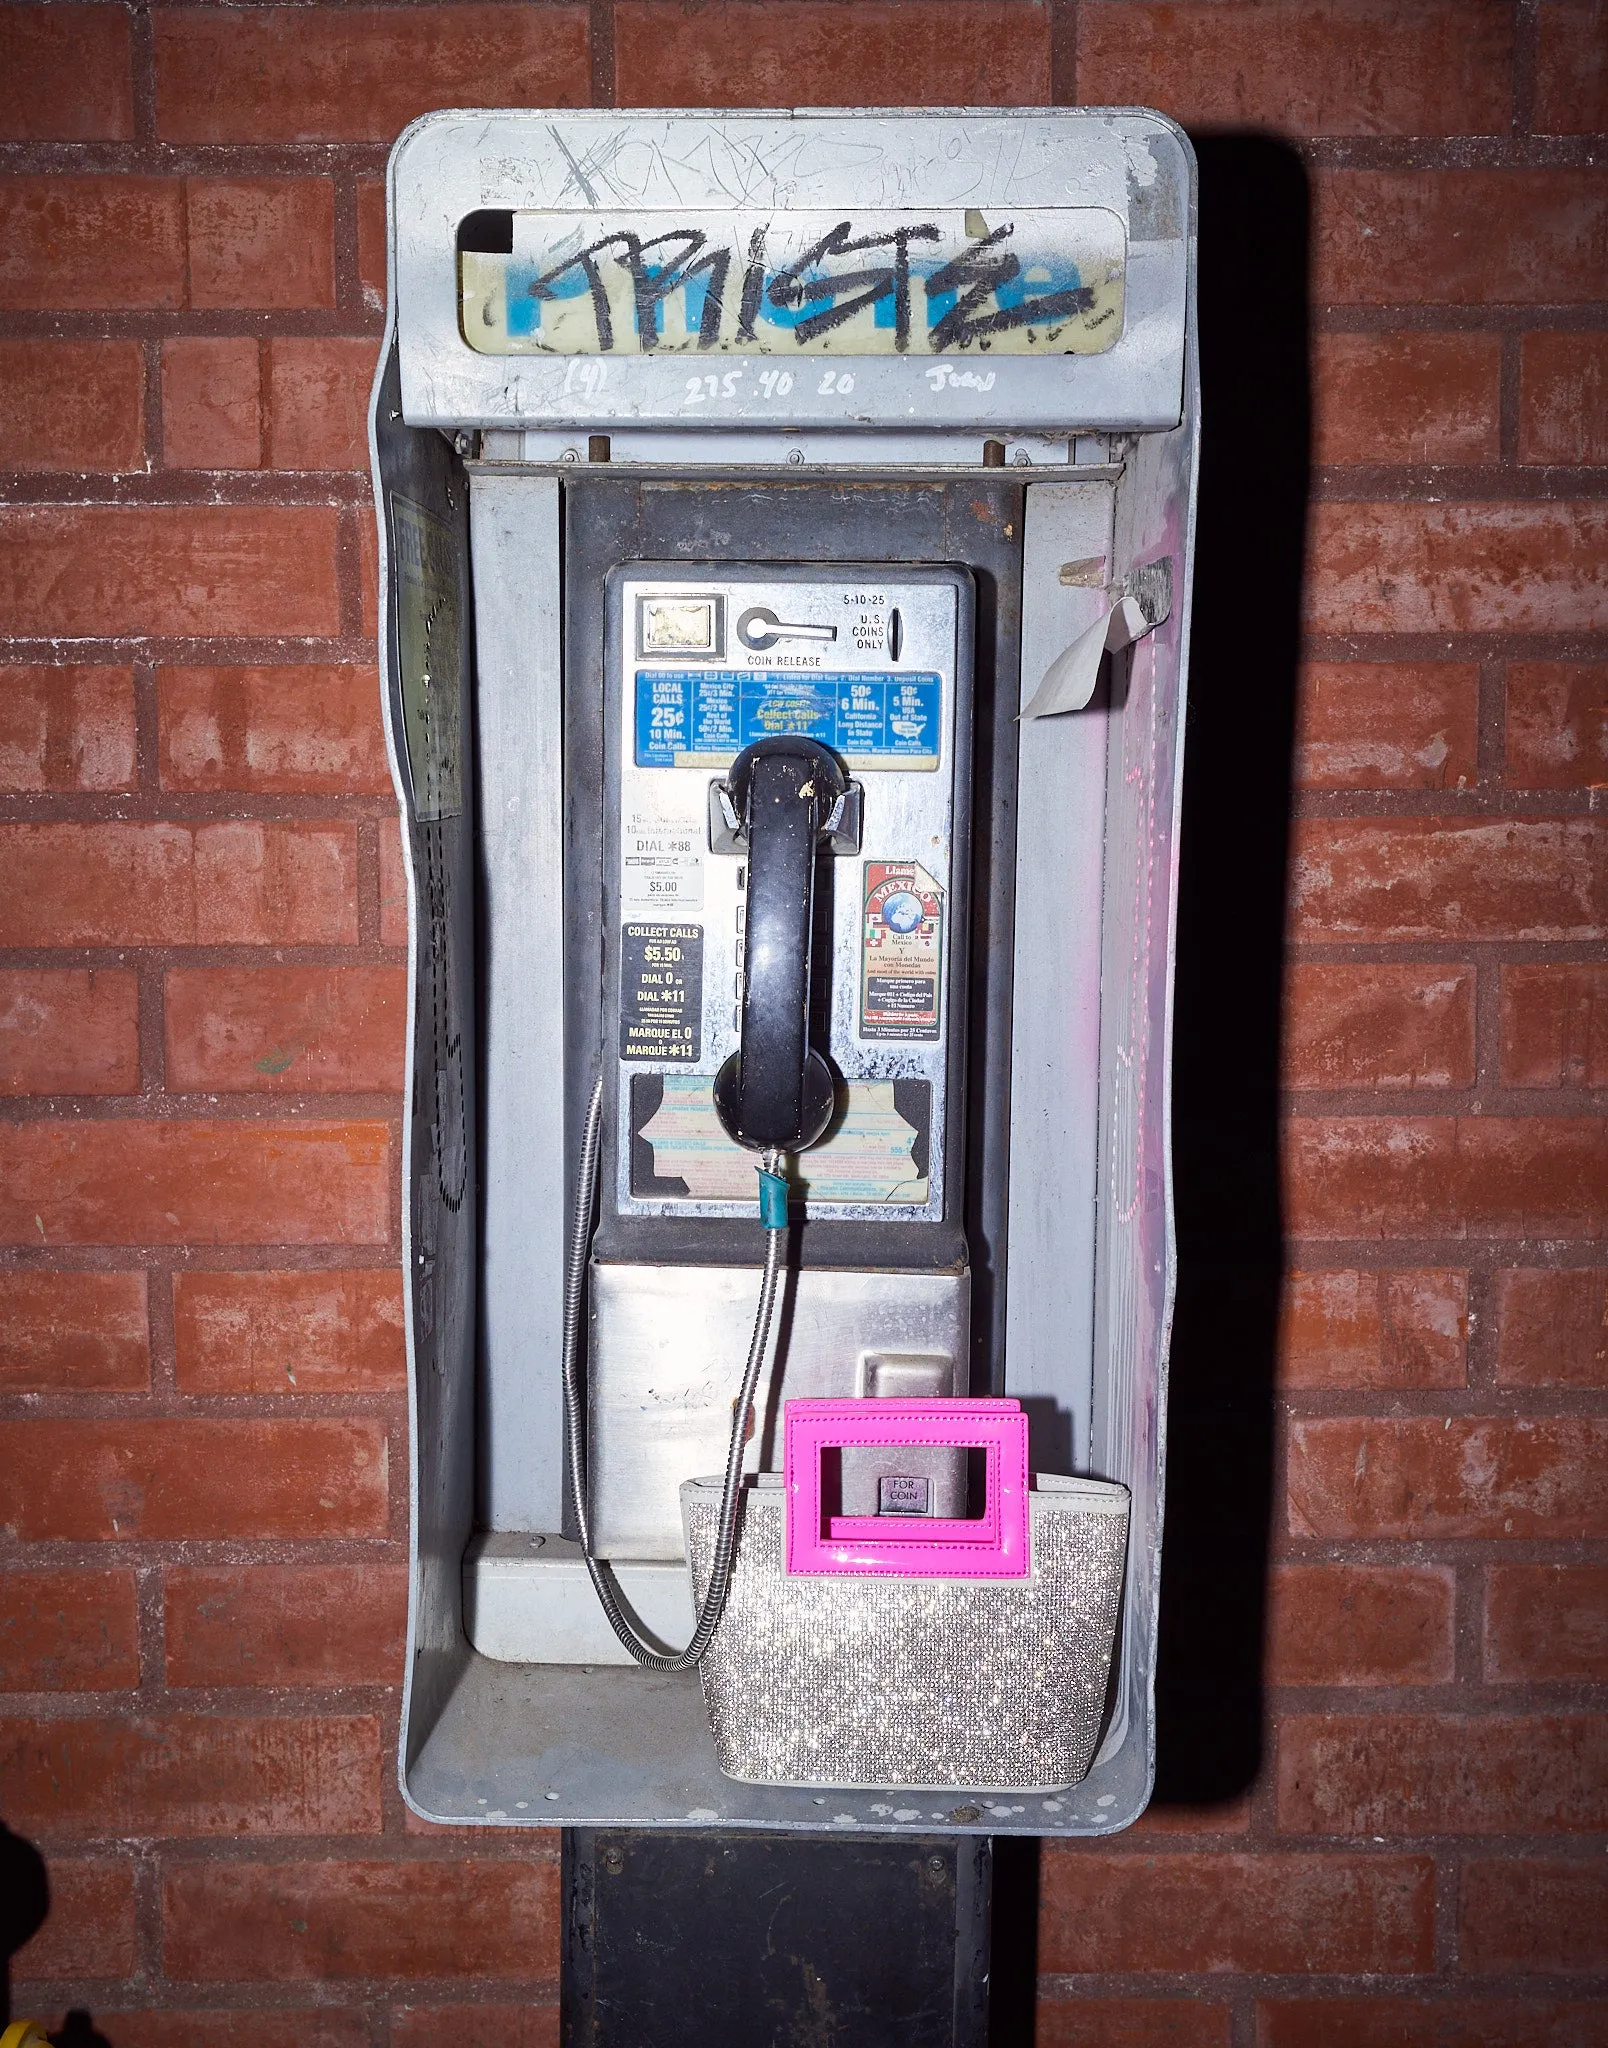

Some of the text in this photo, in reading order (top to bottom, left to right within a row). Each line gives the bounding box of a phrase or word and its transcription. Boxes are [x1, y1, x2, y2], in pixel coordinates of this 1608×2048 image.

[861, 615, 885, 624] U.S.
[852, 627, 884, 637] COINS
[857, 639, 884, 649] ONLY
[747, 656, 821, 667] COIN RELEASE
[652, 683, 683, 693] LOCAL
[850, 685, 872, 698] 50¢
[900, 686, 918, 696] 50¢
[652, 693, 683, 704] CALLS
[893, 696, 924, 707] 5 Min.
[841, 698, 880, 711] 6 Min.
[651, 707, 685, 727] 25¢
[756, 709, 792, 719] Collect
[844, 712, 877, 720] California
[889, 713, 901, 721] Out
[764, 720, 783, 730] Dial
[838, 721, 883, 730] Long Distance
[649, 729, 686, 739] 10 Min.
[855, 729, 873, 737] State
[649, 741, 686, 751] Coin Calls
[631, 814, 642, 823] 15
[626, 825, 637, 834] 10
[637, 840, 664, 851] DIAL
[885, 865, 915, 875] Llame
[649, 881, 677, 892] $5.00
[627, 926, 699, 938] COLLECT CALLS
[644, 945, 681, 962] $5.50
[641, 973, 664, 984] DIAL
[637, 990, 660, 1002] DIAL
[629, 1027, 670, 1039] MARQUE
[671, 1028, 683, 1039] EL
[626, 1044, 668, 1056] MARQUE
[893, 1480, 914, 1489] FOR
[890, 1491, 918, 1500] COIN
